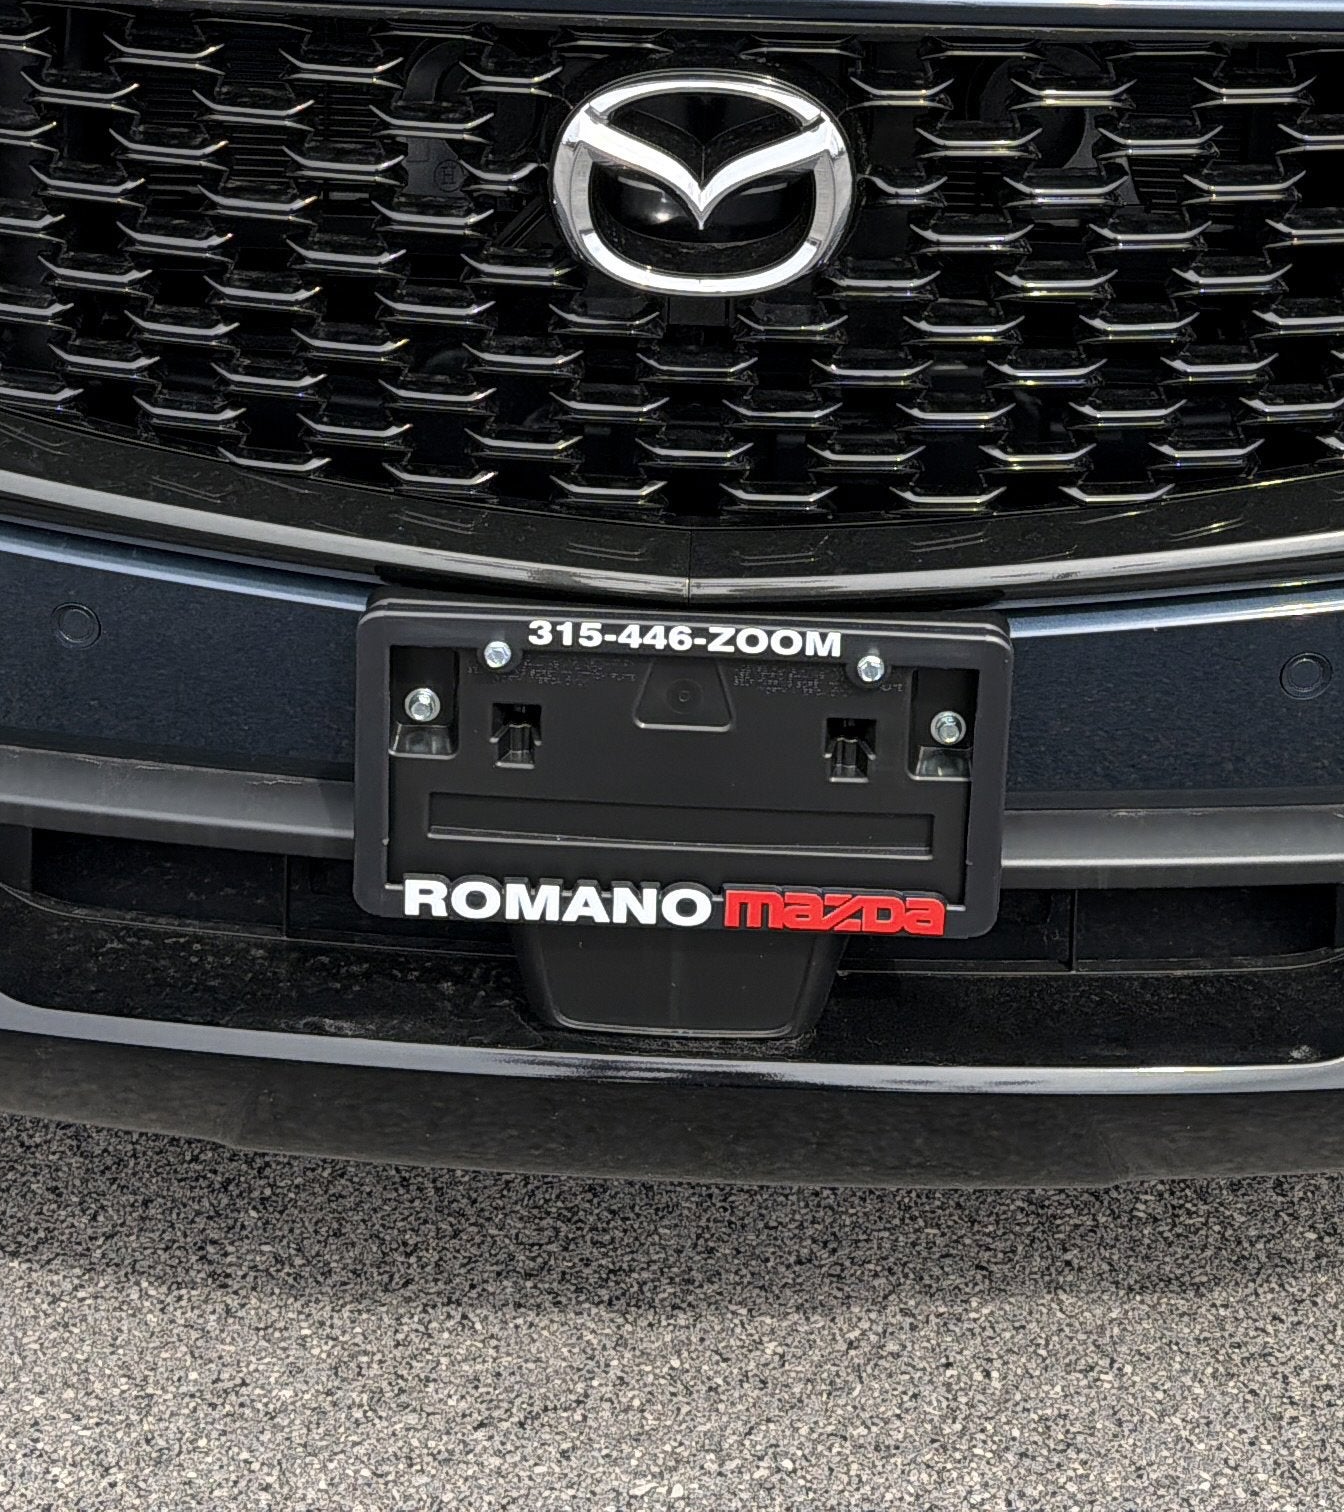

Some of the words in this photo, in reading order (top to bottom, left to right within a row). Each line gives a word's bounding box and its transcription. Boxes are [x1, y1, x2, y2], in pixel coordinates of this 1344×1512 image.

[528, 619, 842, 658] 315-446-ZOOM
[403, 879, 712, 927] ROMANO
[723, 888, 946, 936] mazda
